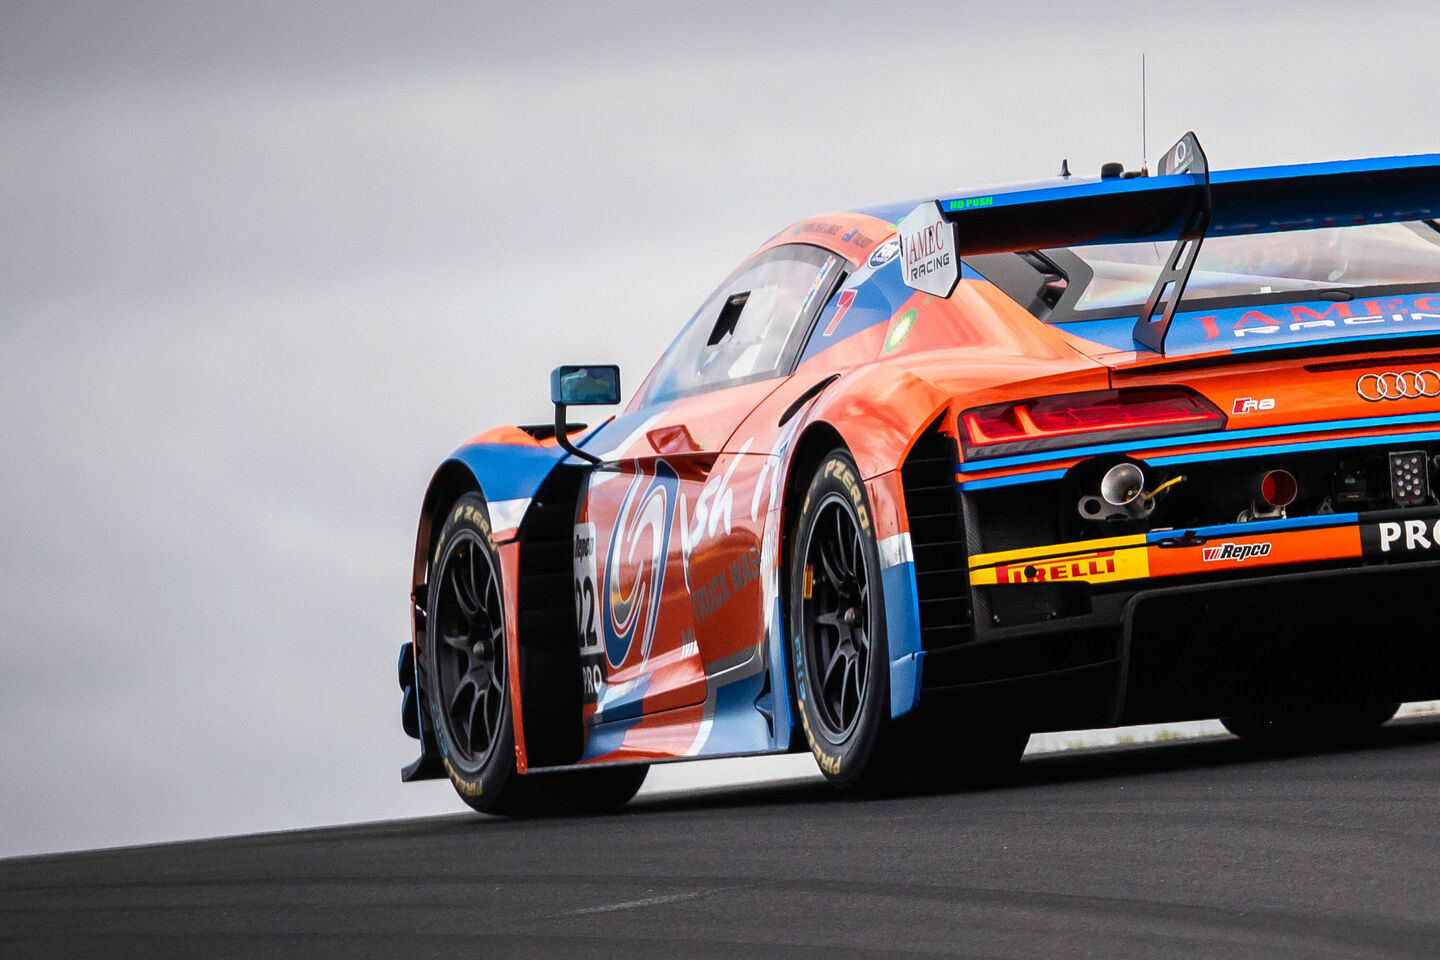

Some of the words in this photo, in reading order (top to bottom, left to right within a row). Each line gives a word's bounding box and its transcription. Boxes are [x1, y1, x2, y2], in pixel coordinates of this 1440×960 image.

[950, 200, 964, 210] NO
[966, 196, 993, 208] PUSH
[904, 220, 944, 281] JAMEC
[911, 252, 950, 281] RACING
[1241, 397, 1276, 412] R8
[995, 549, 1116, 584] PIRELLI
[1220, 543, 1272, 561] Repco
[690, 567, 732, 625] TRUCK
[582, 664, 602, 694] PRO
